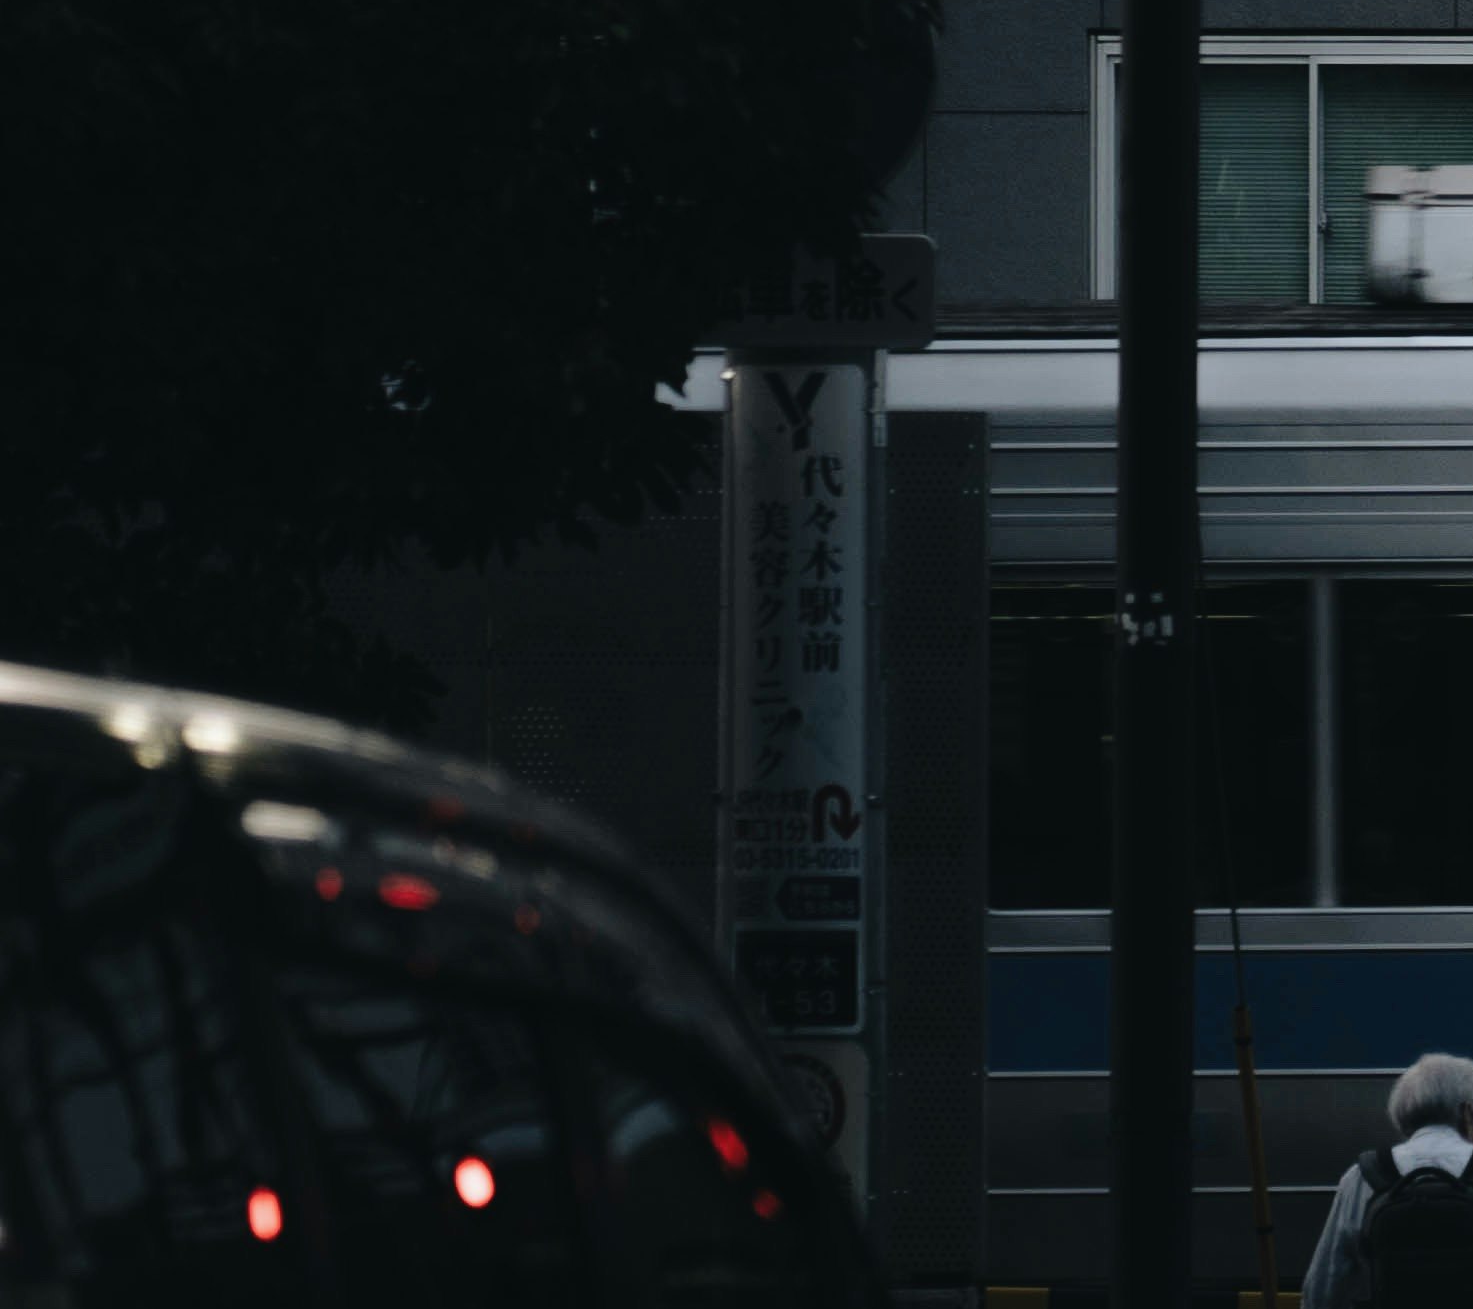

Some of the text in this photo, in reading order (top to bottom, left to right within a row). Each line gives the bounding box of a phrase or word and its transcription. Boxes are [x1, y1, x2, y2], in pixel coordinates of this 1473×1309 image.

[749, 499, 791, 779] 美容クリニック
[796, 454, 844, 674] 代々木駅前
